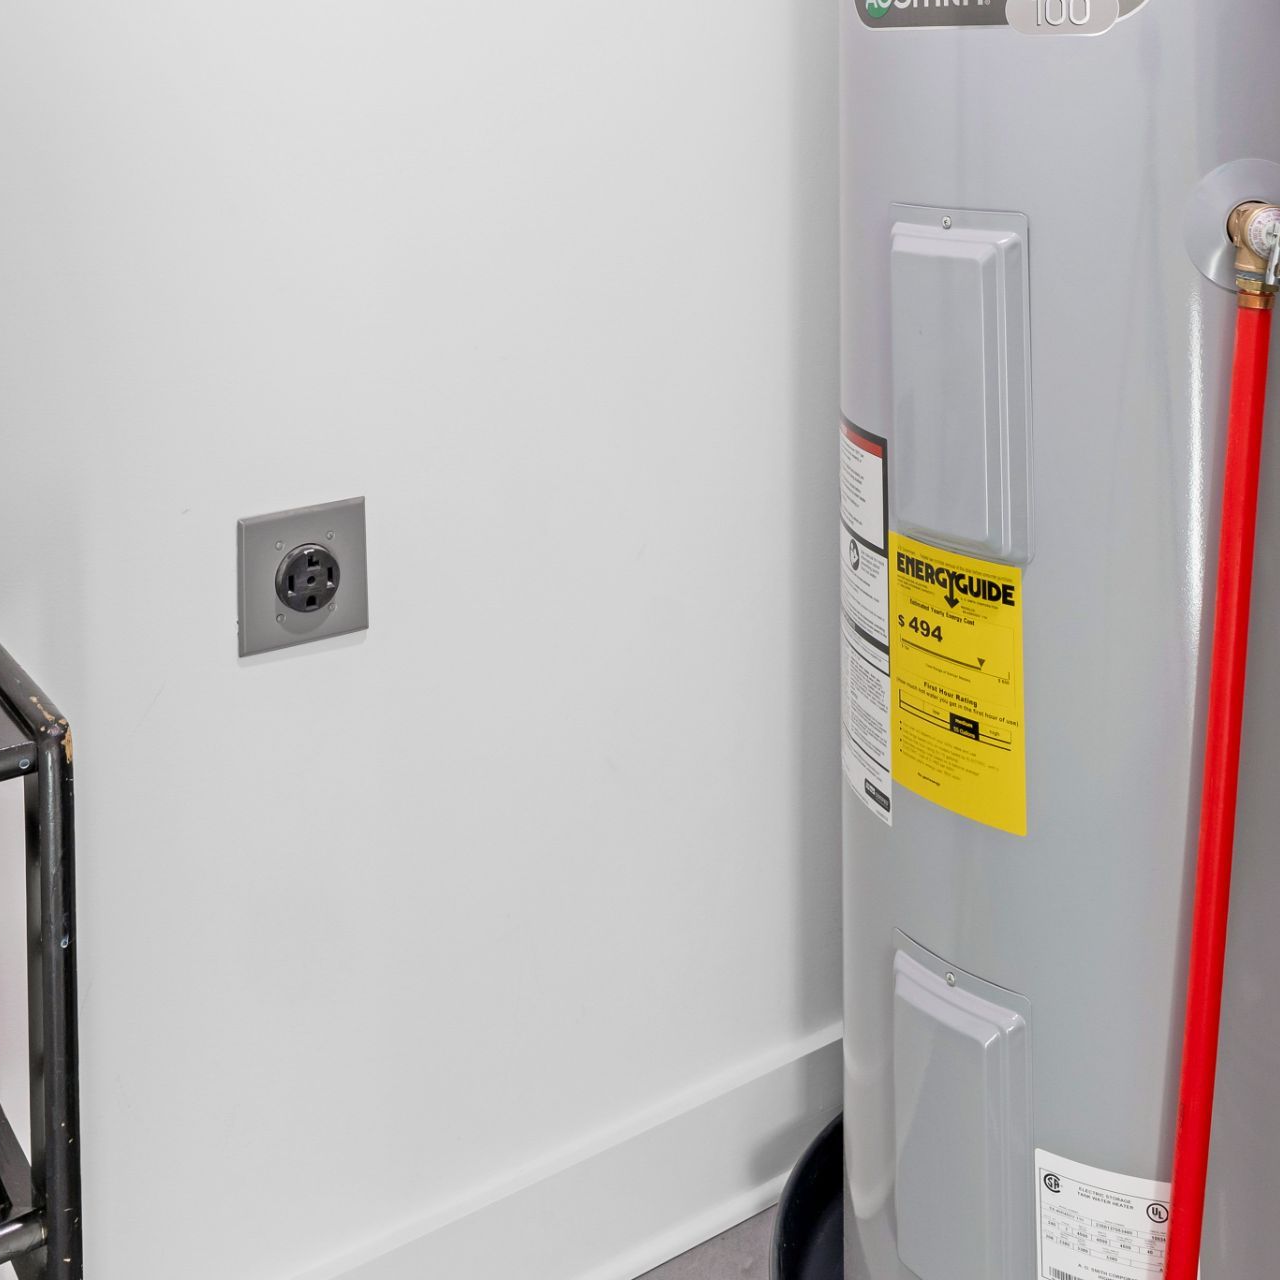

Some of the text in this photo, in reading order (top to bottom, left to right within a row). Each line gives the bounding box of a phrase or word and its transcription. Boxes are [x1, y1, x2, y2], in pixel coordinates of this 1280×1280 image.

[896, 551, 1015, 607] ENERGYGUIDE
[898, 614, 943, 642] $ 494
[923, 681, 978, 708] First Hour Rating
[1151, 1207, 1164, 1220] UL
